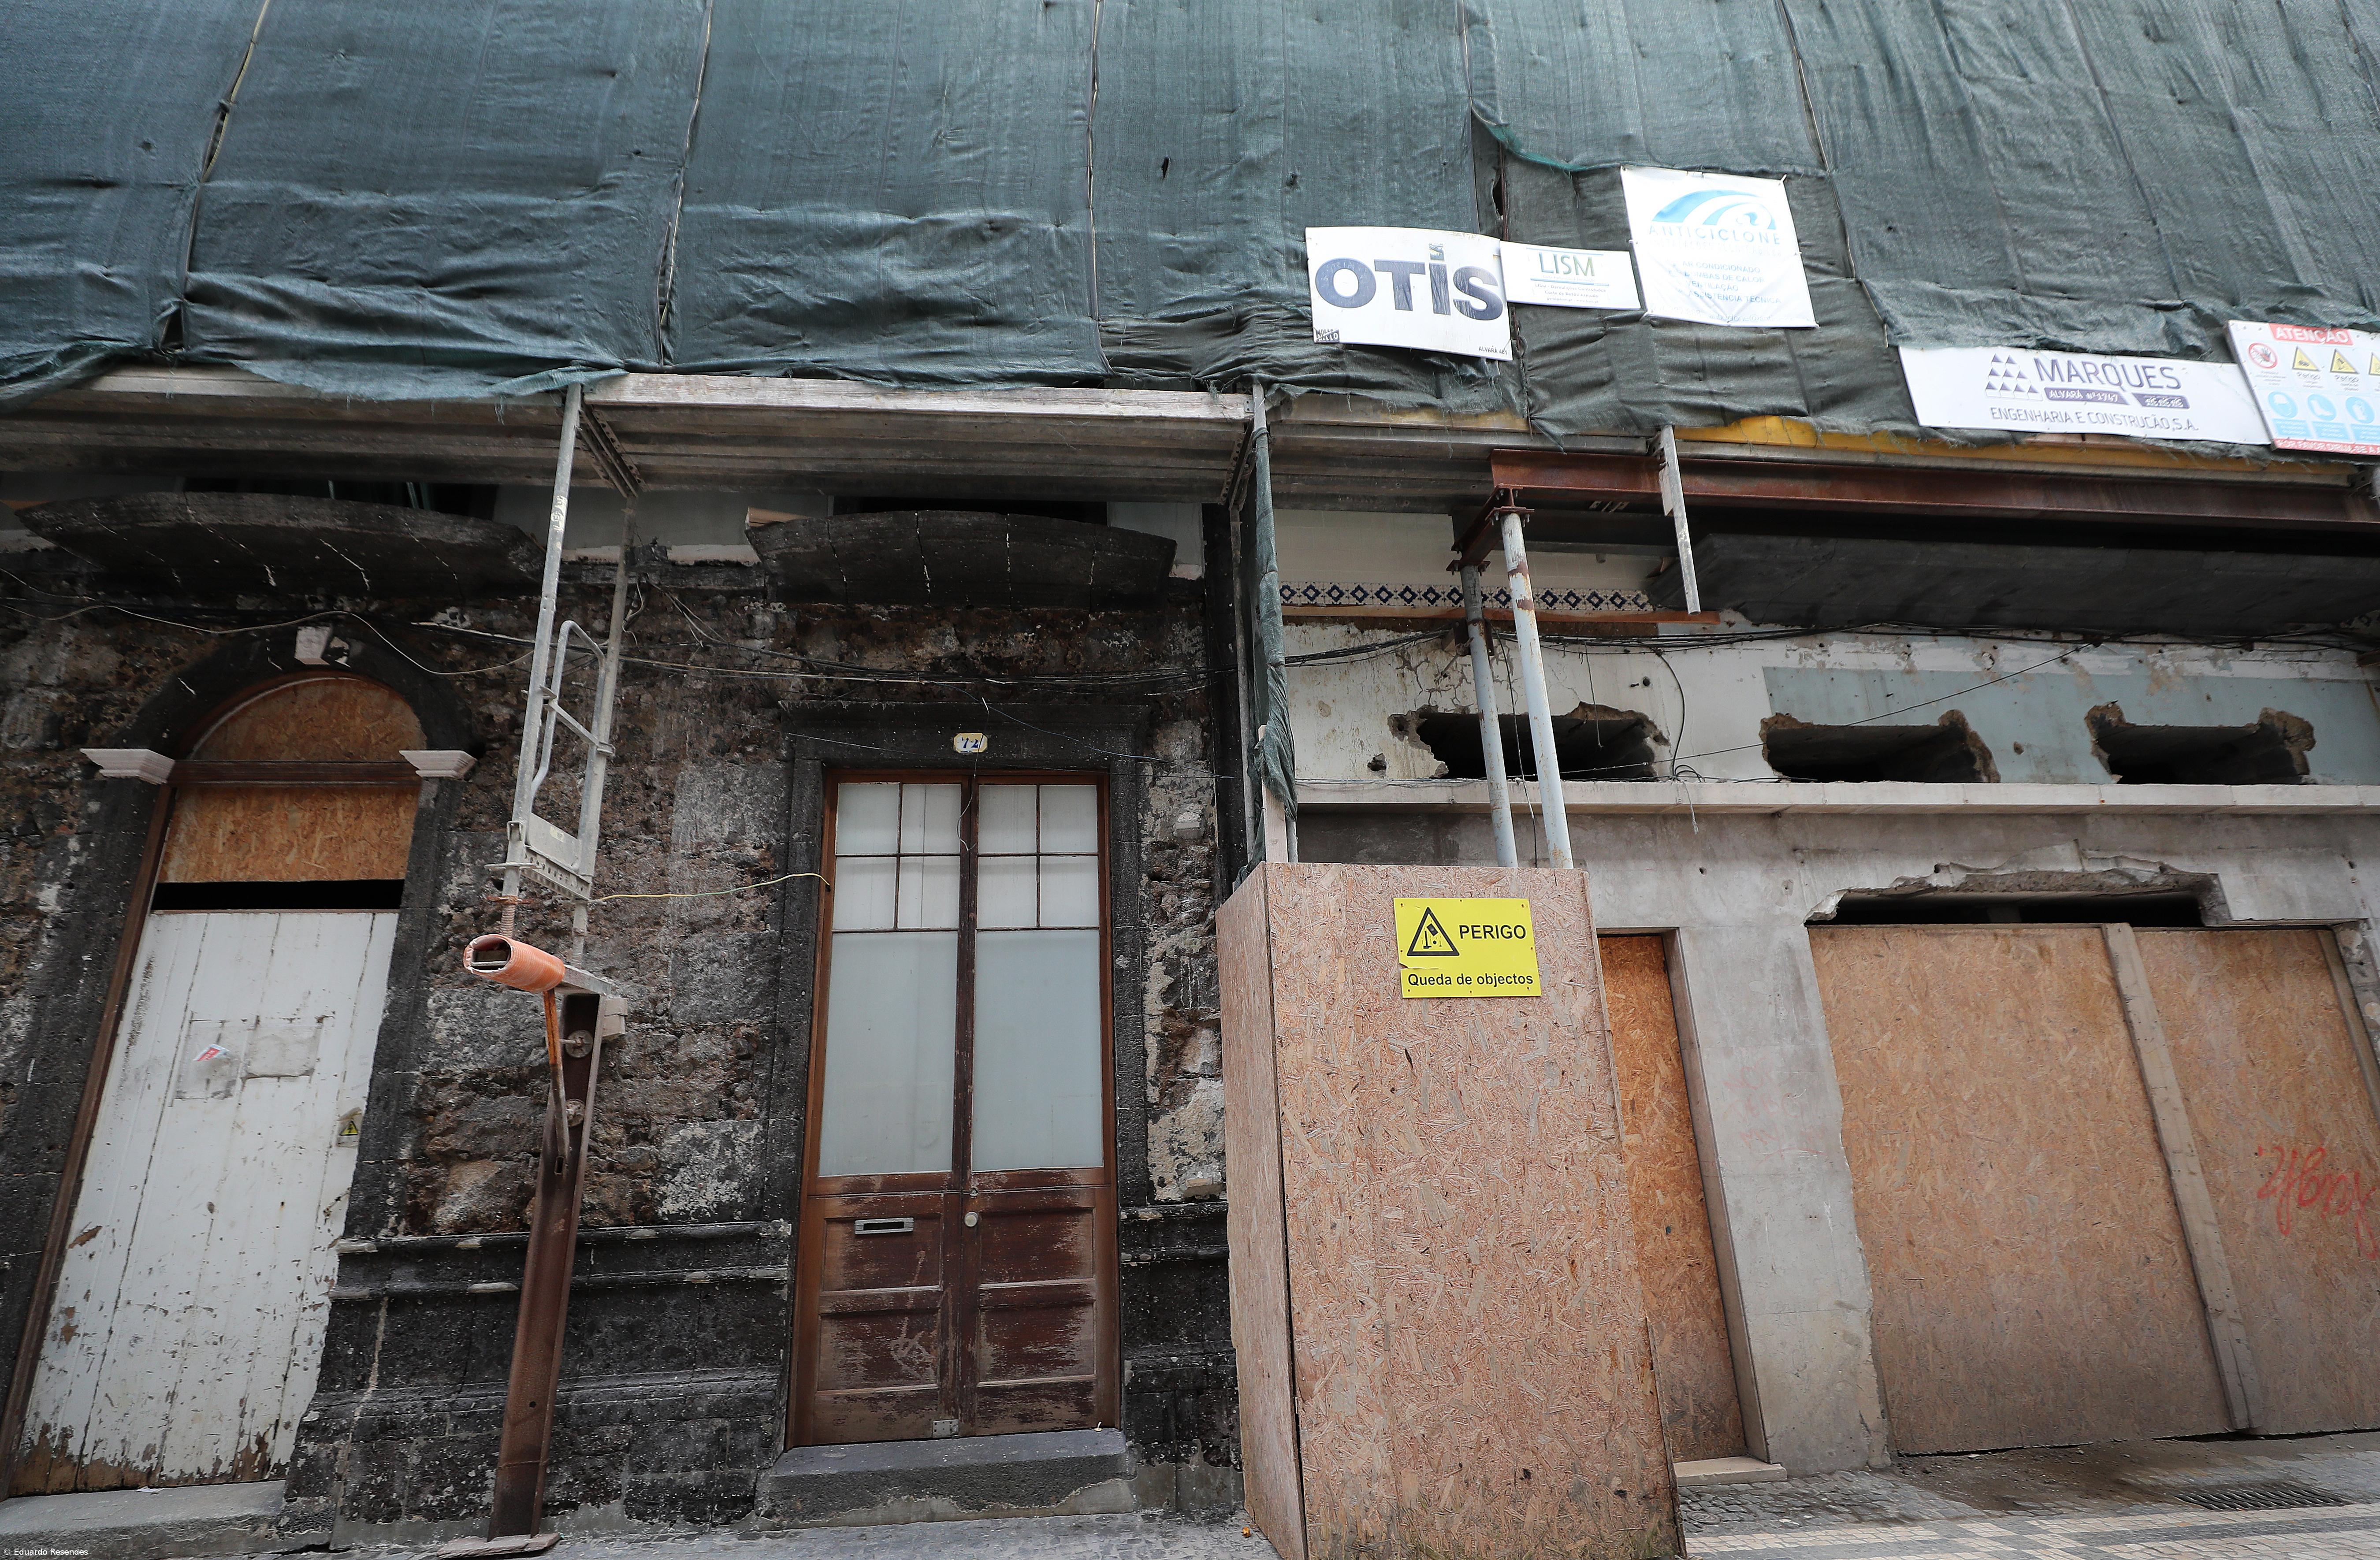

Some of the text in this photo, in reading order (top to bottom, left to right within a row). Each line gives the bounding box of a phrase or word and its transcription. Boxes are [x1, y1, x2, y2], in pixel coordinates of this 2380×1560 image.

[1649, 225, 1781, 245] ANTICICLONE
[1539, 252, 1595, 276] LISM
[1696, 262, 1760, 273] CONDICIONADO
[2034, 357, 2182, 392] MARQUES
[1990, 406, 2073, 423] ENGENHARIA
[2077, 411, 2086, 423] E
[1459, 925, 1526, 939] PERIGO
[1408, 973, 1533, 988] Queda de objectos
